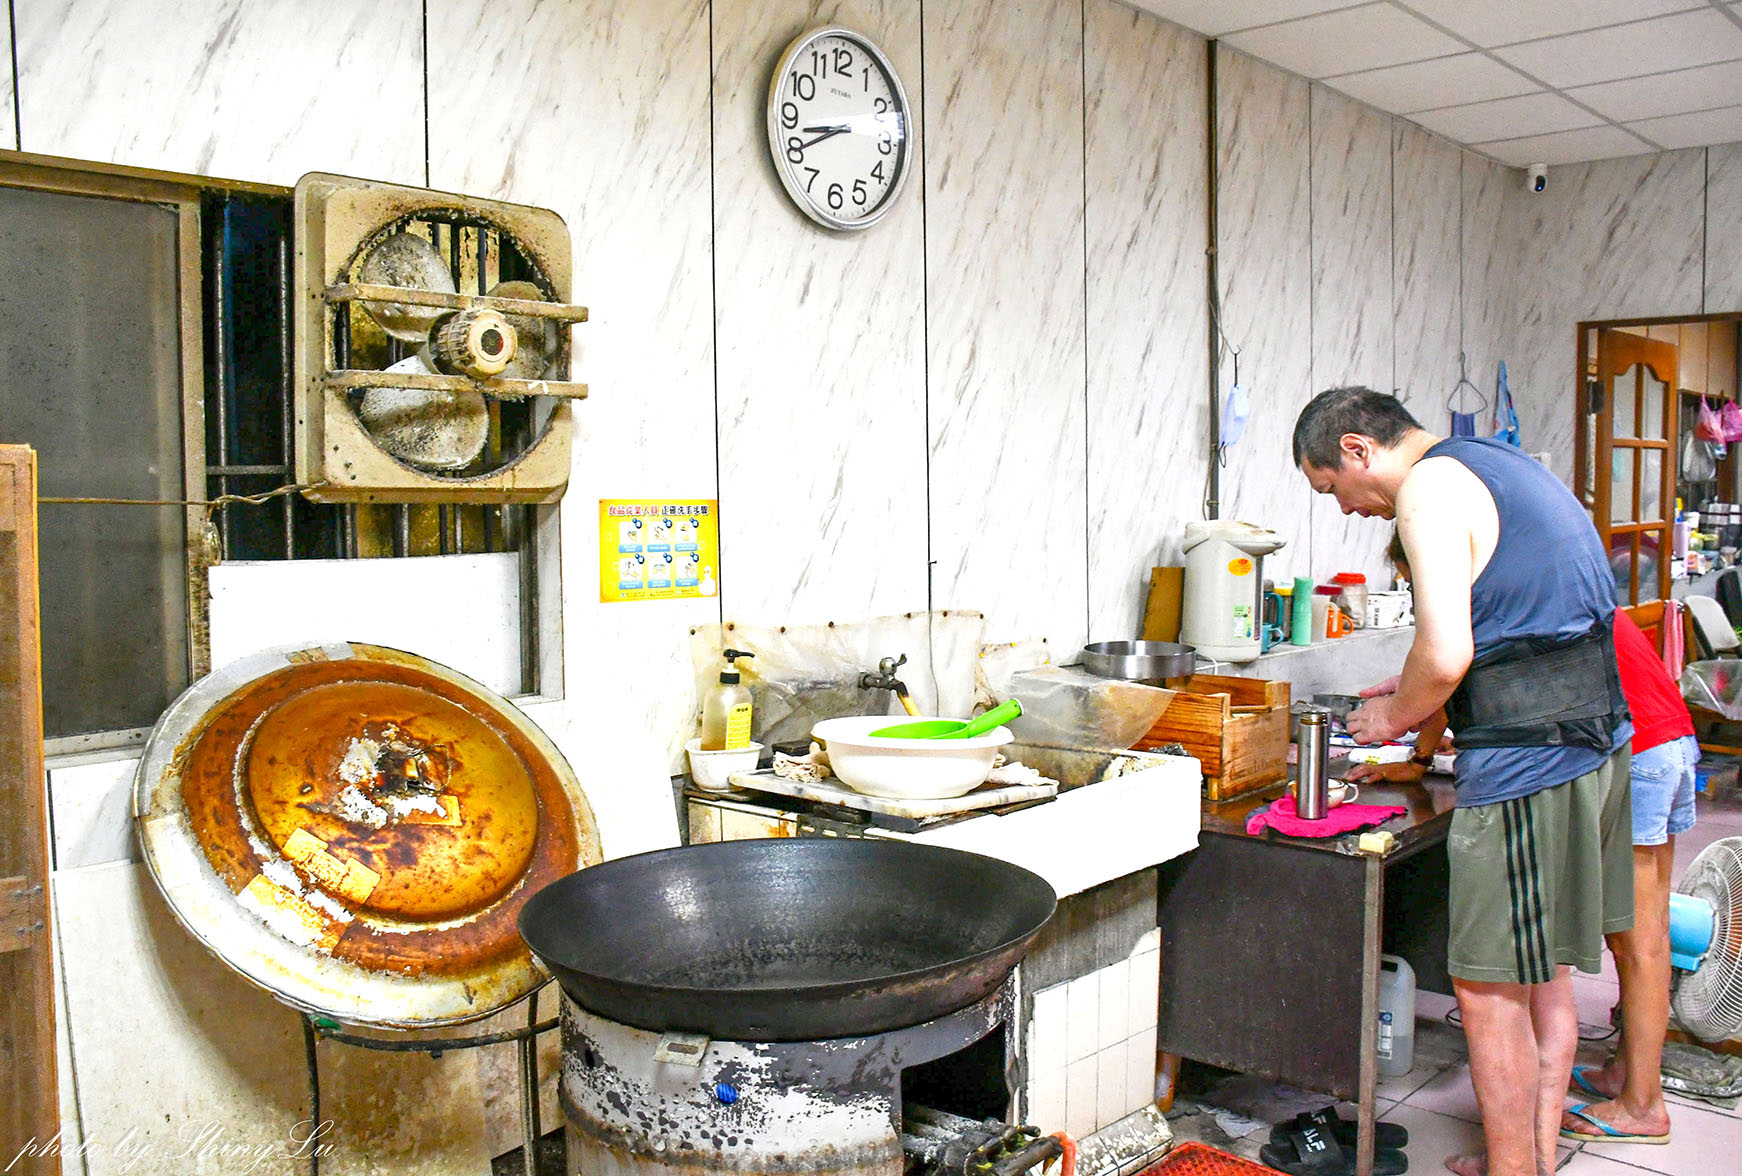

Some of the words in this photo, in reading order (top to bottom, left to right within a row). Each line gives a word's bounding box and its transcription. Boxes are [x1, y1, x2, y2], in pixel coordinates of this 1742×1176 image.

[811, 50, 827, 79] 11
[832, 47, 853, 78] 12
[791, 70, 816, 101] 10
[862, 67, 869, 92] 1
[782, 102, 799, 130] 9
[787, 136, 804, 164] 8
[804, 166, 820, 193] 7
[870, 160, 885, 184] 4
[827, 183, 843, 210] 6
[852, 179, 867, 206] 5
